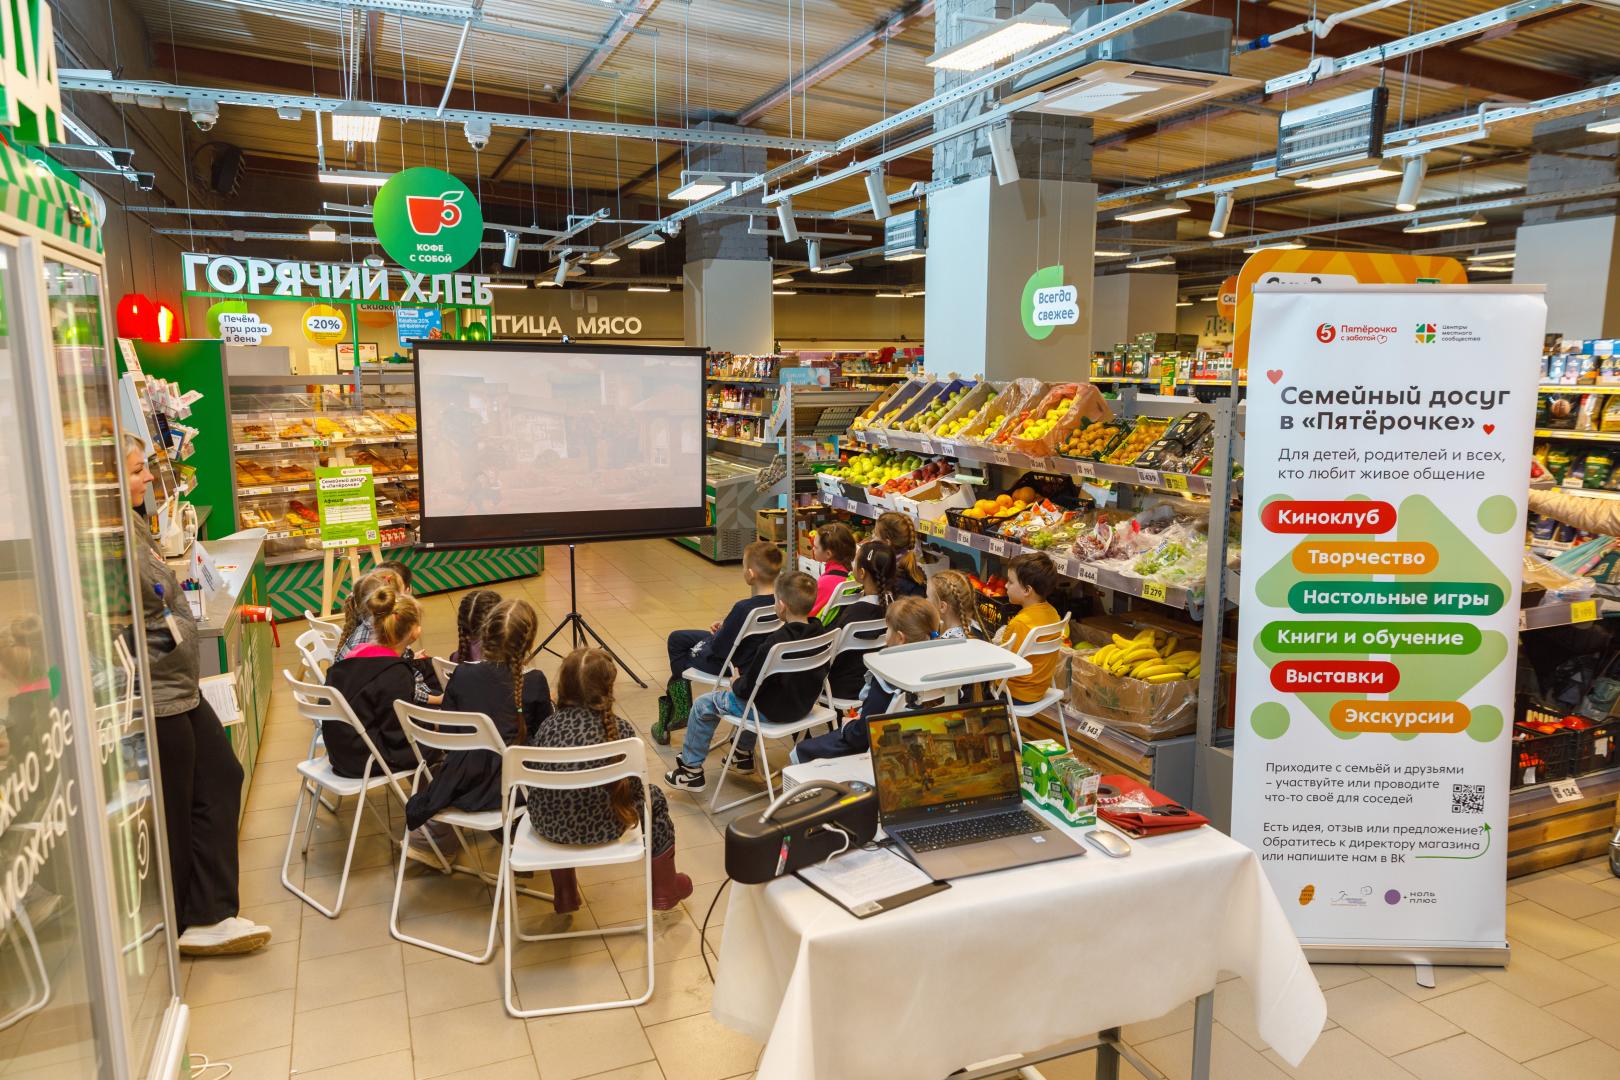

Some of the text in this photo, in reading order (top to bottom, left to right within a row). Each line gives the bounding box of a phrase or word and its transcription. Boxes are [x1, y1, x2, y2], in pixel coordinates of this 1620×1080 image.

[415, 242, 446, 254] КОФЕ
[408, 252, 453, 265] С СОБОЙ
[184, 254, 494, 305] ГОРЯЧИЙ ХЛЕБ
[1038, 289, 1072, 304] Всегда
[223, 315, 255, 323] Печём
[1037, 308, 1075, 321] свежее
[225, 326, 268, 334] три раза
[308, 319, 341, 330] -20%
[577, 316, 642, 335] МЯСО
[1341, 324, 1398, 335] Пятёрочка
[233, 334, 257, 343] день
[1346, 334, 1377, 343] заботой
[1280, 385, 1511, 411] Семейный досуг
[1279, 409, 1475, 435] в «Пятёрочке»
[1277, 448, 1505, 464] Для детей, родителей и всех,
[1278, 466, 1485, 481] кто любит живое общение
[1278, 508, 1380, 527] Киноклуб
[1308, 549, 1426, 568] Творчество
[1083, 570, 1095, 579] 444
[1150, 588, 1162, 598] 279
[1303, 589, 1489, 609] Настольные игры
[1277, 628, 1464, 649] Книги и обучение
[1286, 669, 1385, 684] Выставки
[1345, 708, 1454, 728] Экскурсии
[1086, 725, 1099, 735] 143
[1266, 762, 1464, 776] Приходите с семьёй и друзьями
[1275, 777, 1345, 790] участвуйте
[1347, 780, 1371, 788] или
[1374, 780, 1440, 791] проводите
[1562, 786, 1577, 797] 134
[1264, 792, 1413, 806] что-то своё для соседей
[1263, 822, 1484, 837] Есть идея, отзыв или предложение?
[1262, 836, 1480, 851] Обратитесь к директору магазина
[1262, 853, 1405, 863] или напишите нам в ВК
